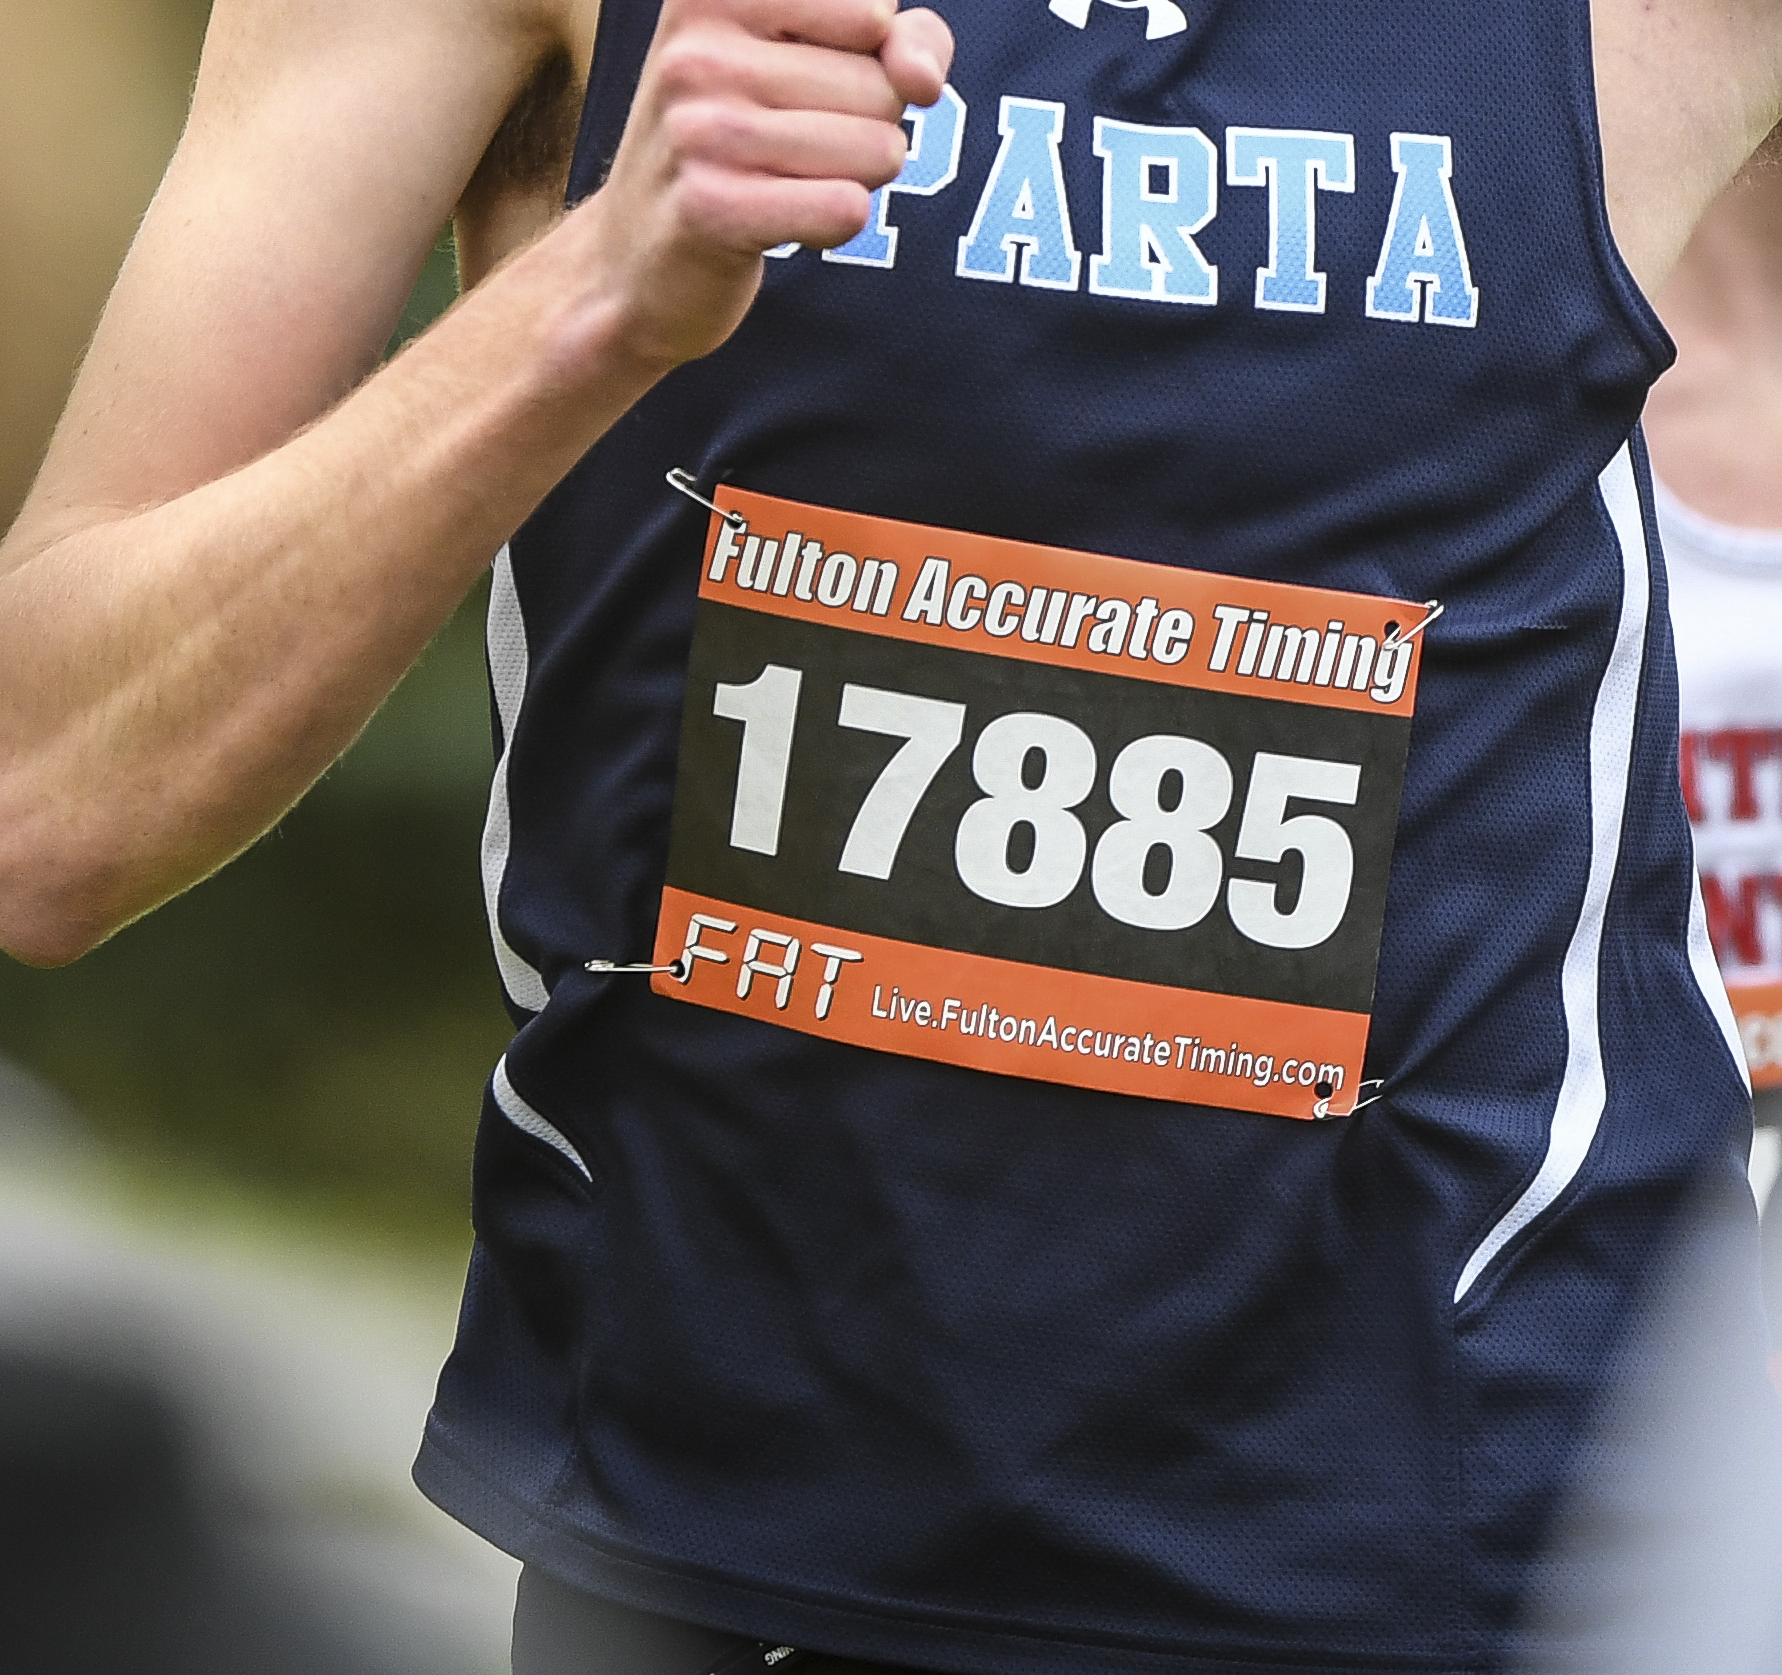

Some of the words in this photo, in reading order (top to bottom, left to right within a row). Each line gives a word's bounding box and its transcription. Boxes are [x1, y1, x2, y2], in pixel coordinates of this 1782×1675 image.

[763, 83, 1479, 328] PARTA
[707, 518, 899, 618] Fulton
[902, 555, 1195, 666] Accurate
[1207, 603, 1414, 704] Timing
[712, 663, 1363, 950] 17885
[675, 913, 864, 1020] FAT
[871, 984, 1345, 1090] Live.FultonAccurateTiming.com
